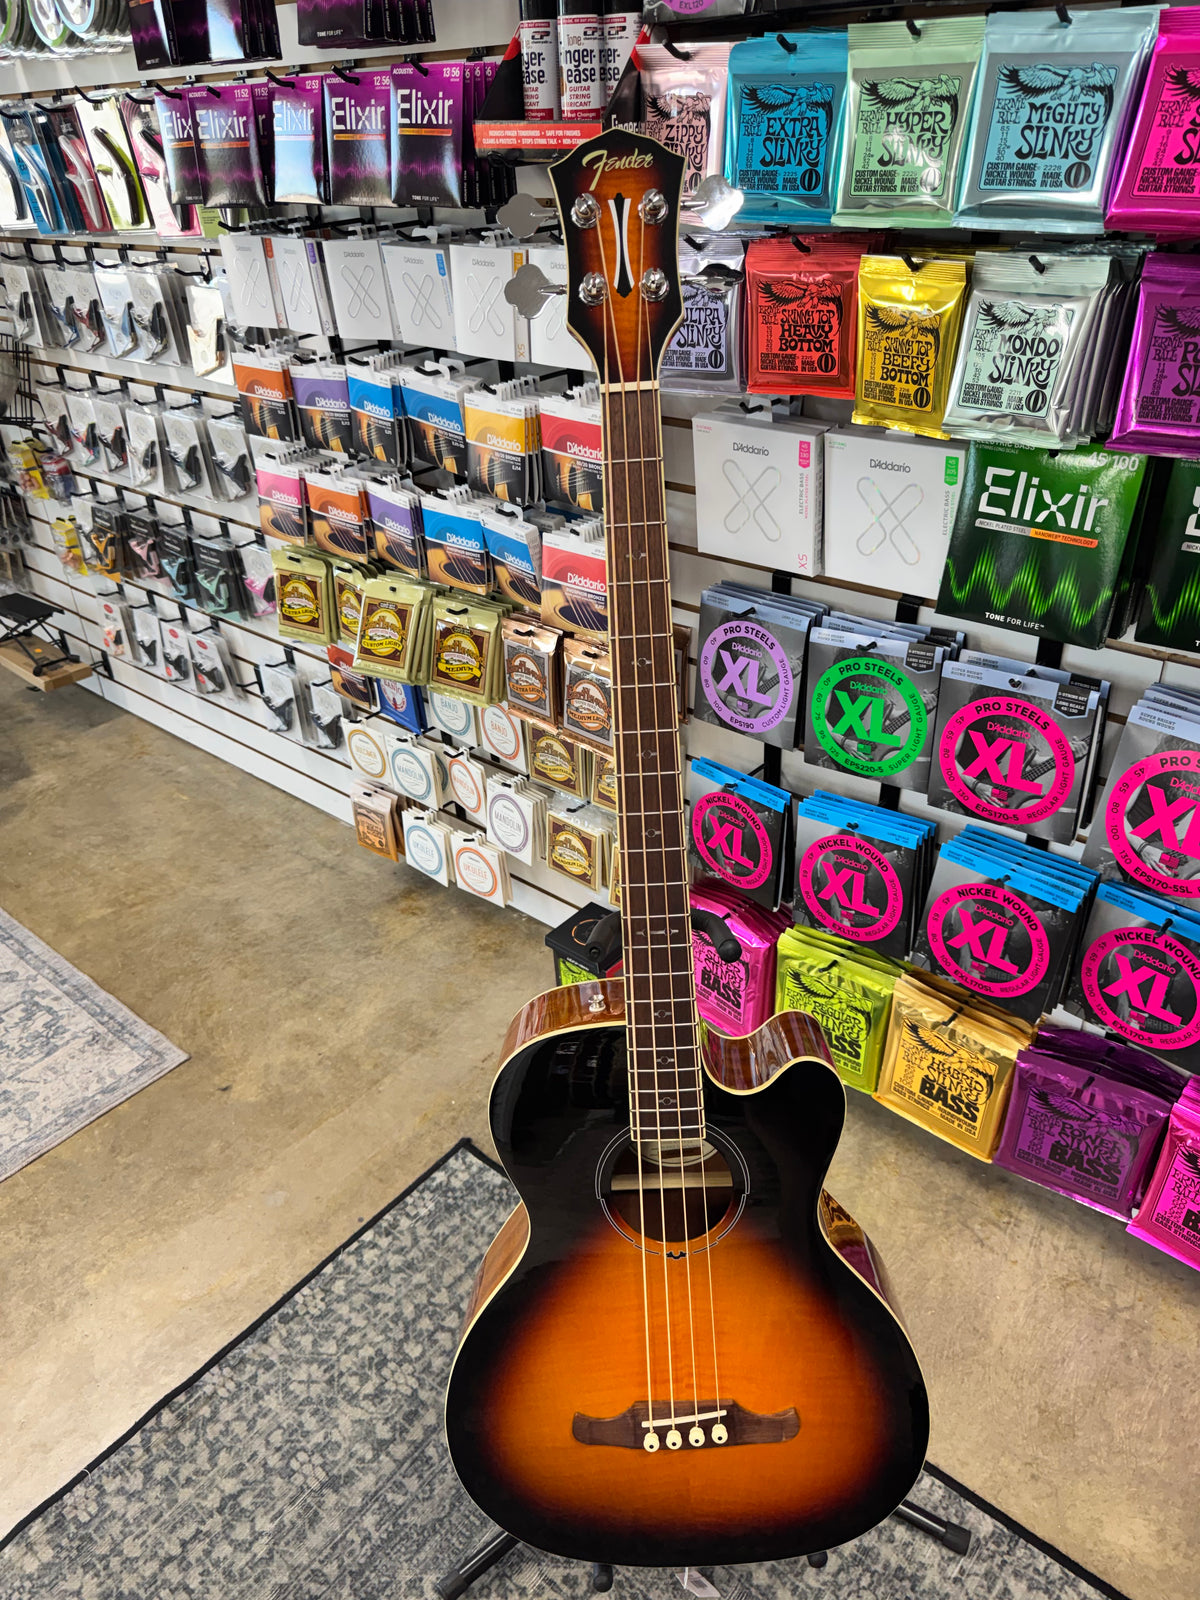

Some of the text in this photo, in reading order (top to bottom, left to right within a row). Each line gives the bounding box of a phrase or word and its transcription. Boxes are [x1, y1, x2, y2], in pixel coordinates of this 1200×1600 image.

[392, 67, 413, 75] ACOUSTIC
[331, 97, 386, 130] Elixir
[397, 89, 454, 125] Elixir
[195, 110, 249, 140] Elixir
[765, 116, 822, 139] EXTRA
[885, 111, 949, 135] HYPER
[582, 148, 654, 191] Fender
[739, 169, 761, 178] CUSTOM
[855, 169, 878, 178] CUSTOM
[987, 162, 1038, 172] CUSTOM GAUGE
[1009, 171, 1035, 179] WOUND
[1042, 172, 1063, 180] MADE
[1142, 167, 1198, 176] CUSTOM GAUGE
[983, 178, 1037, 187] GUITAR STRINGS
[1049, 180, 1063, 188] USA
[1137, 184, 1196, 194] GUITAR STRINGS
[1140, 176, 1195, 185] NICKEL WOUND
[817, 309, 835, 325] TOP
[780, 324, 833, 339] HEAVY
[779, 338, 834, 353] BOTTOM
[913, 341, 932, 357] TOP
[1000, 333, 1062, 356] MONDO
[882, 352, 932, 372] BEEFY
[881, 366, 931, 387] BOTTOM
[427, 412, 462, 432] D'Addario
[486, 433, 522, 452] D'Addario
[733, 442, 769, 457] D'Addario
[870, 458, 911, 473] D'Addario
[1112, 455, 1140, 471] 100
[978, 466, 1109, 532] Elixir
[446, 532, 480, 549] D'Addario
[979, 519, 1094, 546] NICKEL TECHNOLOGY
[567, 572, 606, 591] D'Addario
[284, 607, 301, 616] EXTRA
[985, 612, 1005, 622] TONE
[1007, 616, 1022, 626] FOR
[362, 639, 384, 649] CUSTOM
[723, 625, 775, 650] PRO STEELS
[732, 642, 762, 658] D'Addario
[445, 665, 475, 673] MEDIUM
[716, 649, 772, 707] XL
[838, 662, 903, 685] PRO STEELS
[512, 684, 529, 693] EXTRA
[850, 681, 888, 695] D'Addario
[569, 710, 592, 721] MEDIUM
[761, 687, 790, 728] CUSTOM LIGHT
[974, 702, 1050, 730] PRO STEELS
[831, 689, 901, 747] XL
[490, 720, 508, 737] BANJO
[888, 692, 924, 770] SUPER LIGHT GAUGE
[987, 722, 1031, 739] D'Addario
[844, 758, 884, 773] EPS220-5
[962, 729, 1043, 795] XL
[1159, 756, 1191, 769] PRO
[1026, 738, 1070, 819] REGULAR LIGHT GAUGE
[494, 810, 522, 831] MANDOLIN
[705, 796, 761, 831] NICKEL WOUND
[975, 803, 1020, 821] EPS170-5
[706, 813, 754, 871] XL
[818, 839, 889, 873] NICKEL WOUND
[1119, 850, 1132, 865] 130
[463, 863, 488, 879] UKULELE
[1133, 867, 1193, 894] EPS170-5SL
[817, 860, 880, 918] XL
[957, 888, 1038, 931] NICKEL WOUND
[974, 904, 1014, 926] D'Addario
[946, 906, 1019, 976] XL
[1114, 931, 1200, 981] NICKEL WOUND
[1133, 949, 1176, 974] D'Addario
[701, 969, 742, 1010] BASS
[1102, 951, 1183, 1027] XL
[813, 1000, 864, 1031] REGULAR
[1159, 1031, 1192, 1045] REGULAR
[919, 1077, 980, 1123] BASS
[1048, 1142, 1122, 1186] BASS
[1155, 1217, 1173, 1231] BASS
[1156, 1212, 1186, 1233] CUSTOM
